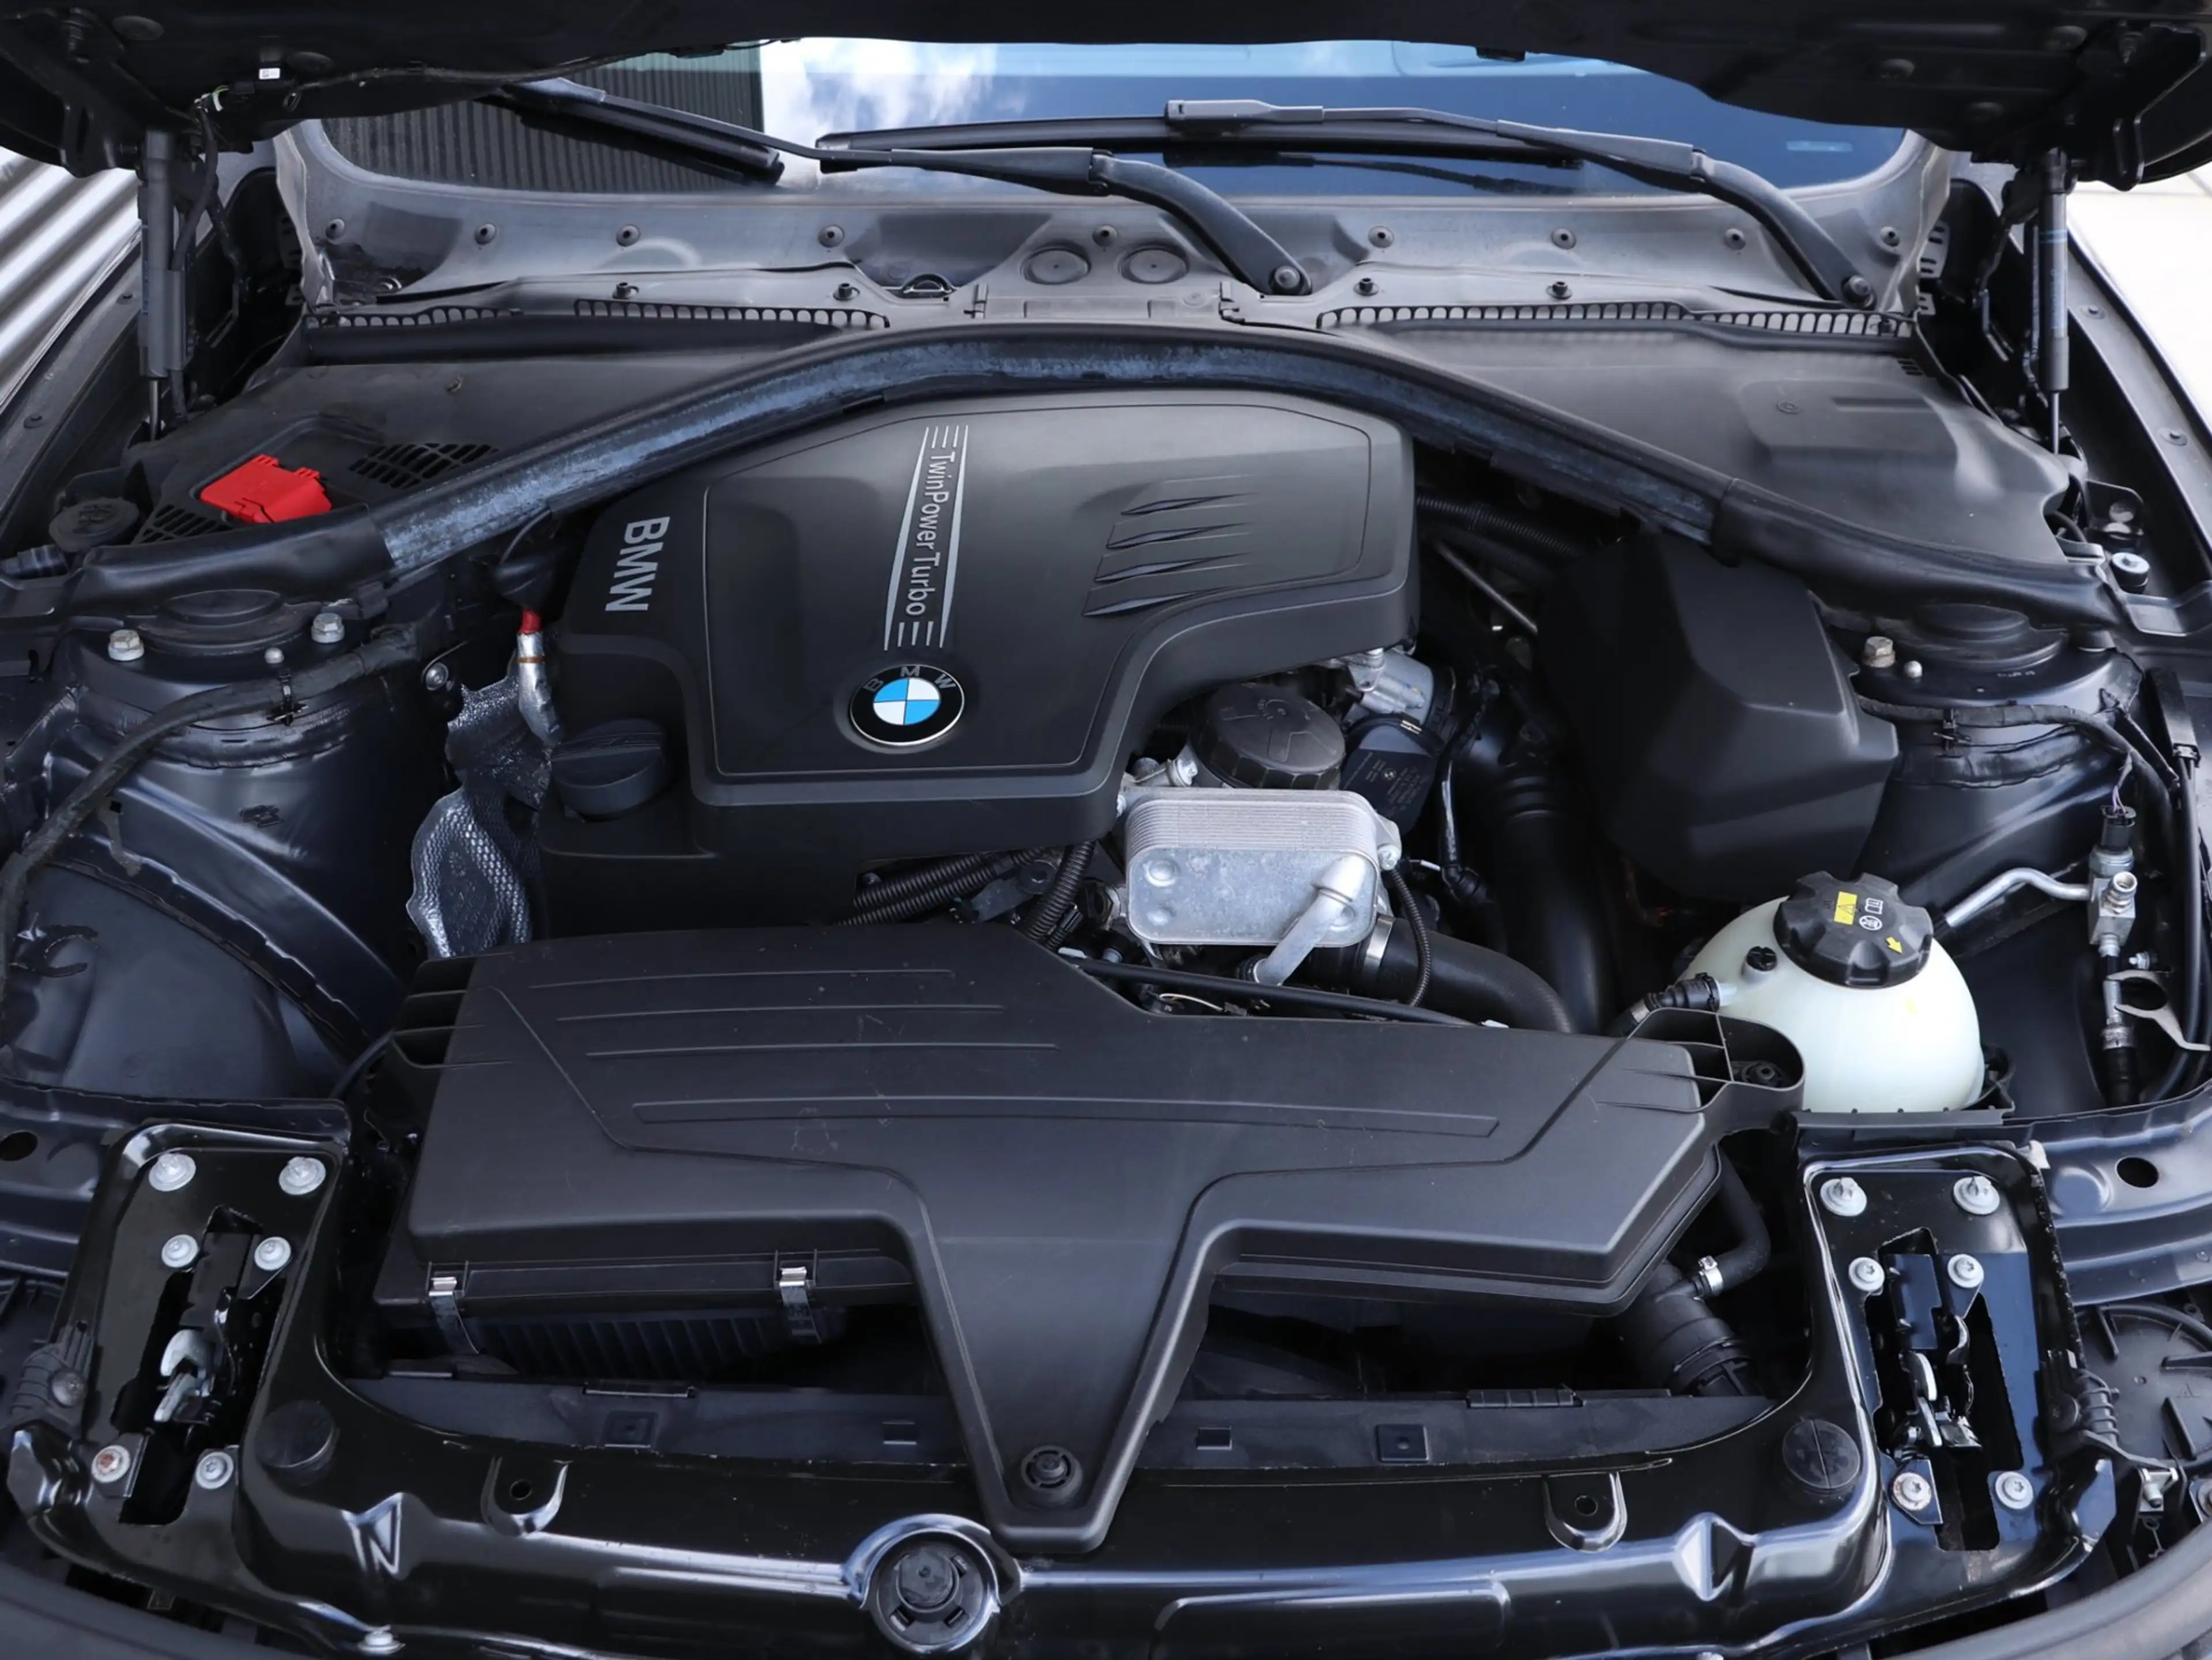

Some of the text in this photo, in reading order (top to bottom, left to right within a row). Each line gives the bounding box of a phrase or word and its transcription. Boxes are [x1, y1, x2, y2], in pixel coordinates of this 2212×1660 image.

[605, 516, 670, 612] BMW
[905, 451, 956, 616] TwinPower Turbo
[863, 665, 957, 692] BMW
